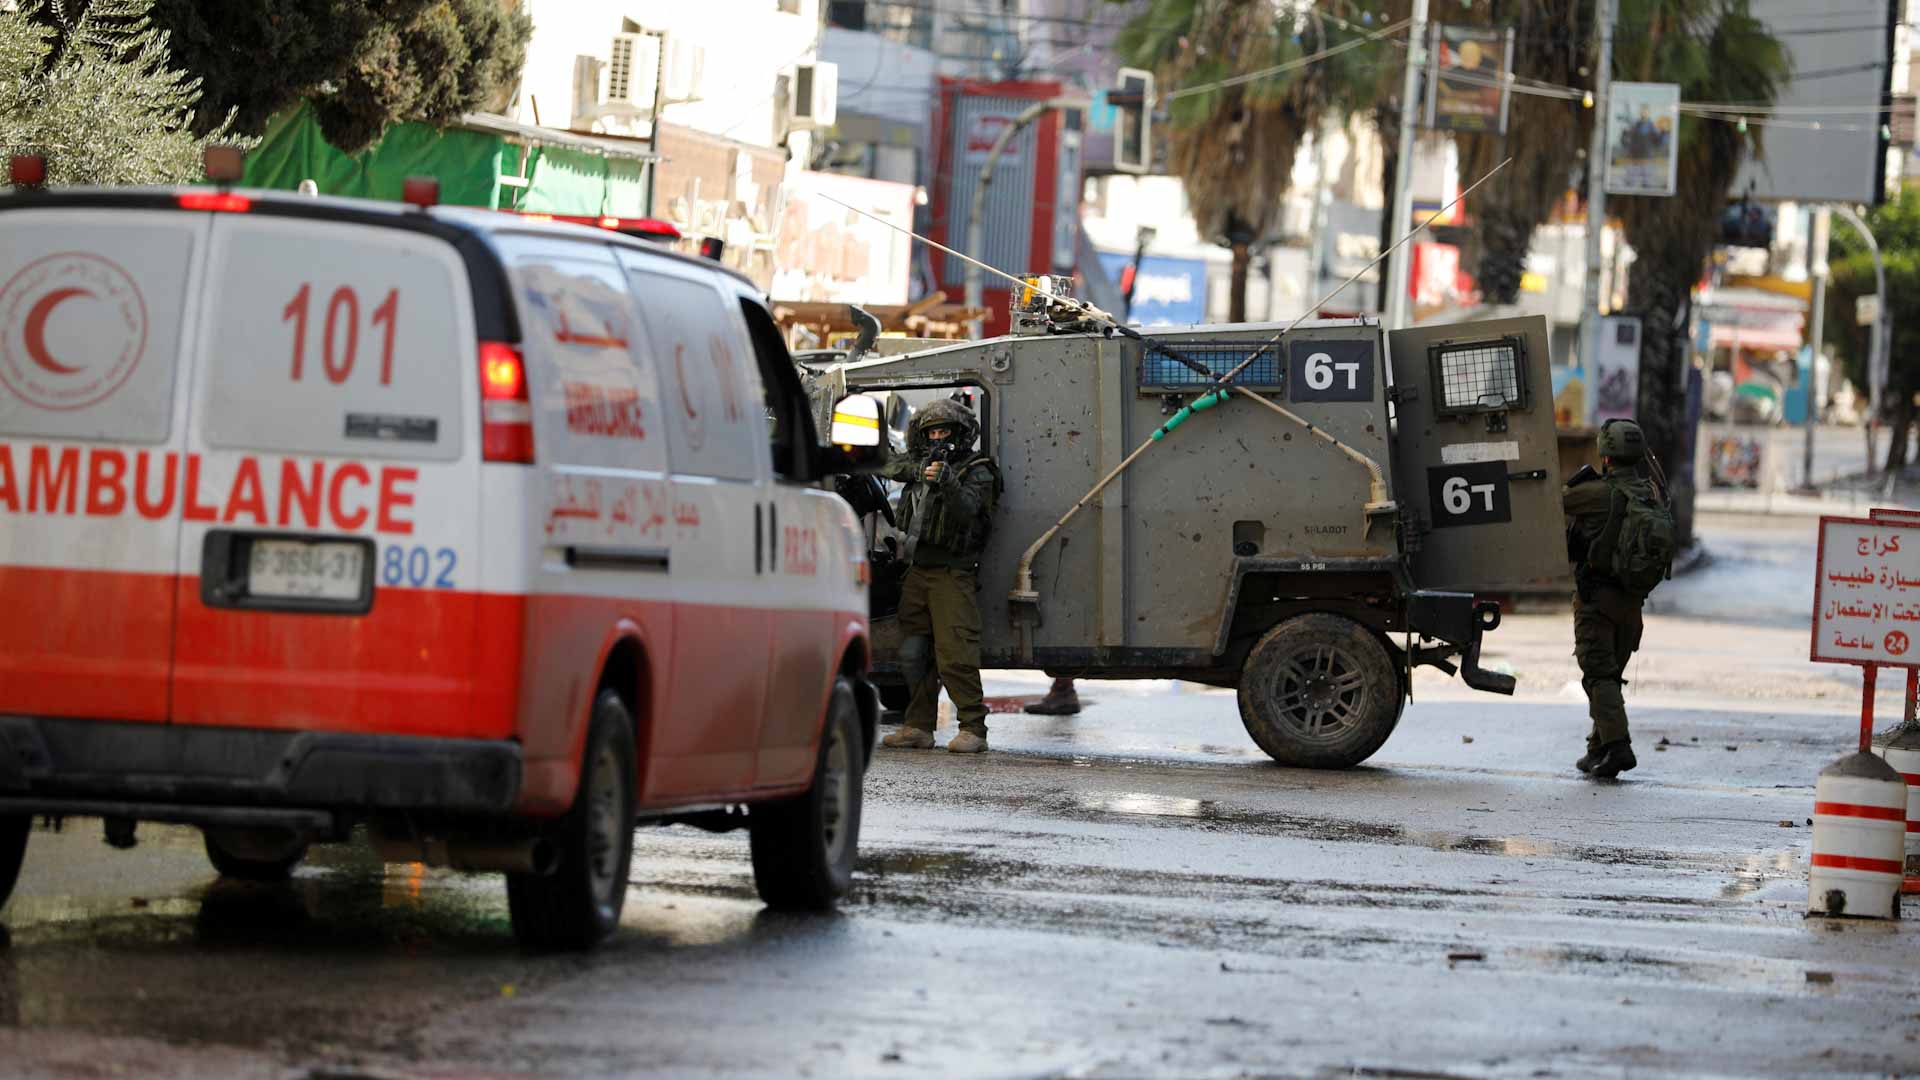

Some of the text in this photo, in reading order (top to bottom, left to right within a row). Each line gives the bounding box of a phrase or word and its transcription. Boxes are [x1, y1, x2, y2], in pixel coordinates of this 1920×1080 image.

[283, 281, 400, 385] 101
[1857, 535, 1900, 556] كراج
[384, 545, 458, 588] 802
[1828, 566, 1875, 589] طبيب
[1834, 631, 1906, 651] 24 ساعة
